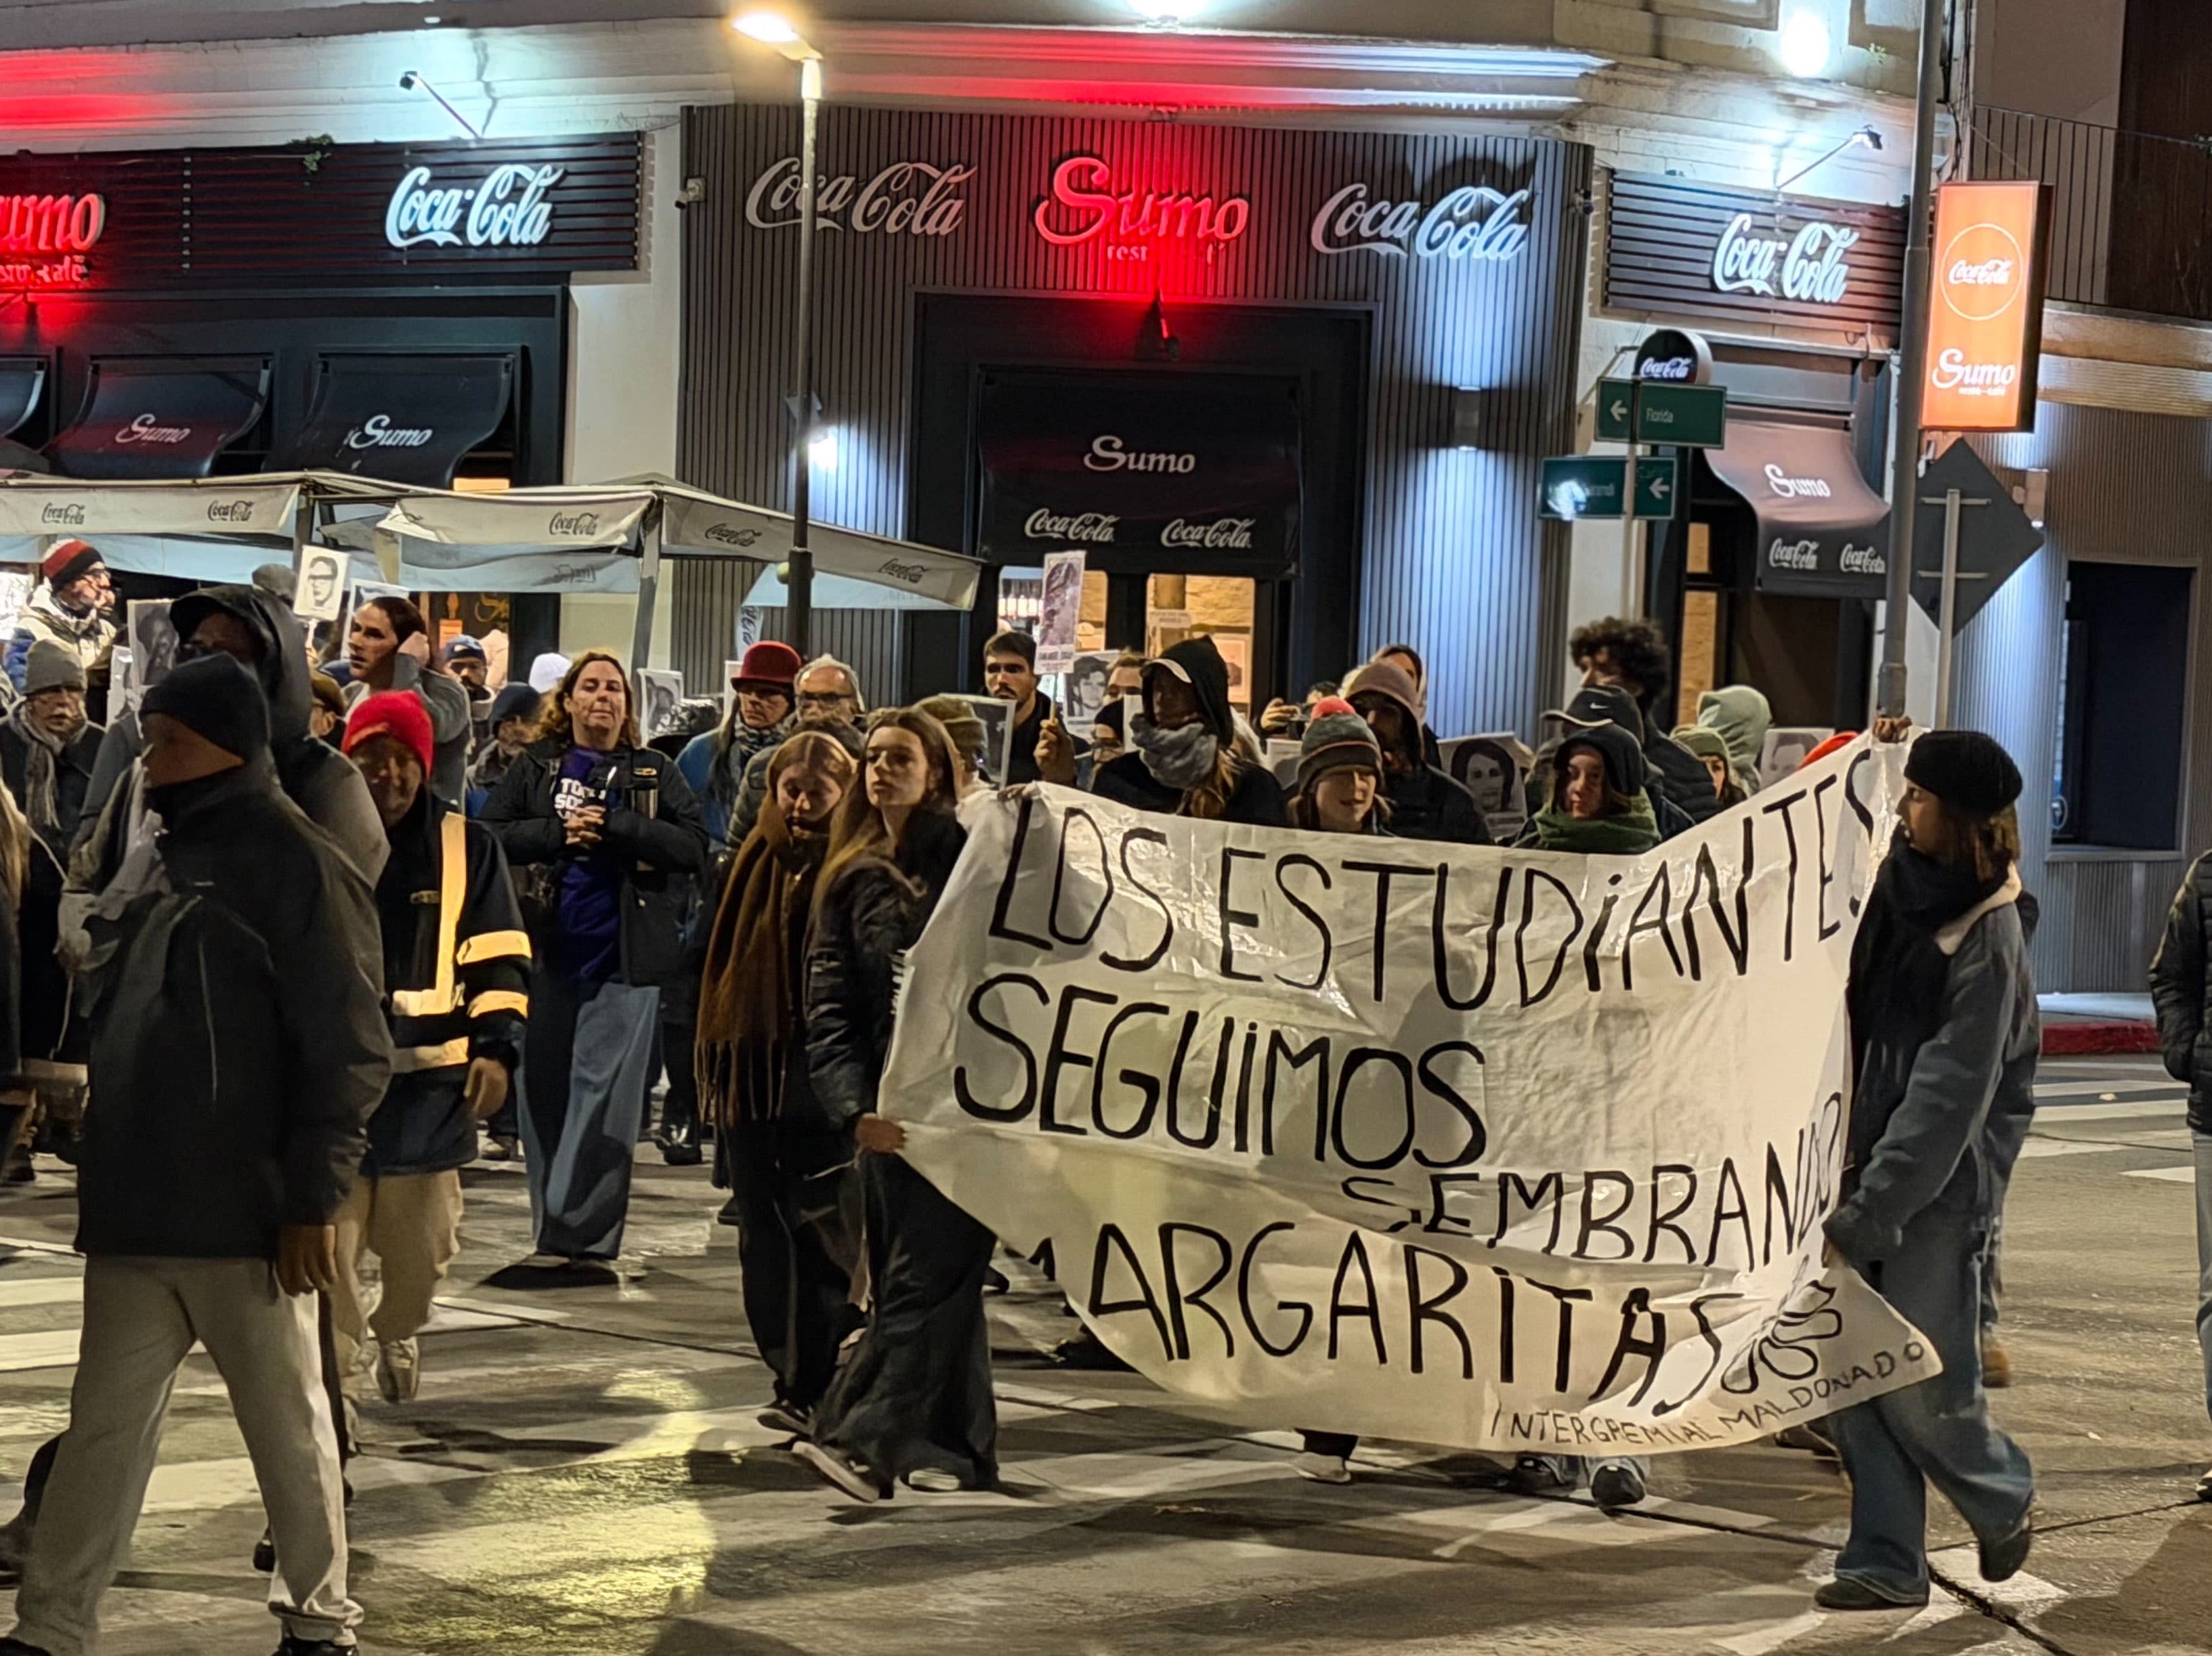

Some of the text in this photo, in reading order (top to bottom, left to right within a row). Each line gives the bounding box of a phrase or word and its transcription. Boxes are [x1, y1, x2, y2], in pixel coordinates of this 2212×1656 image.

[0, 193, 105, 251] umo
[385, 164, 563, 247] Coca-Cola
[1035, 156, 1249, 245] Sumo
[1714, 213, 1860, 303] Coca-Cola
[1932, 347, 2016, 389] Sumo
[115, 413, 191, 443] Sumo
[349, 414, 433, 449] Sumo
[1646, 408, 1674, 423] Florida
[1084, 435, 1196, 473] Sumo
[1764, 463, 1831, 498] Sumo
[988, 798, 1174, 973] LOS
[1718, 1341, 1925, 1432] MALDONADO
